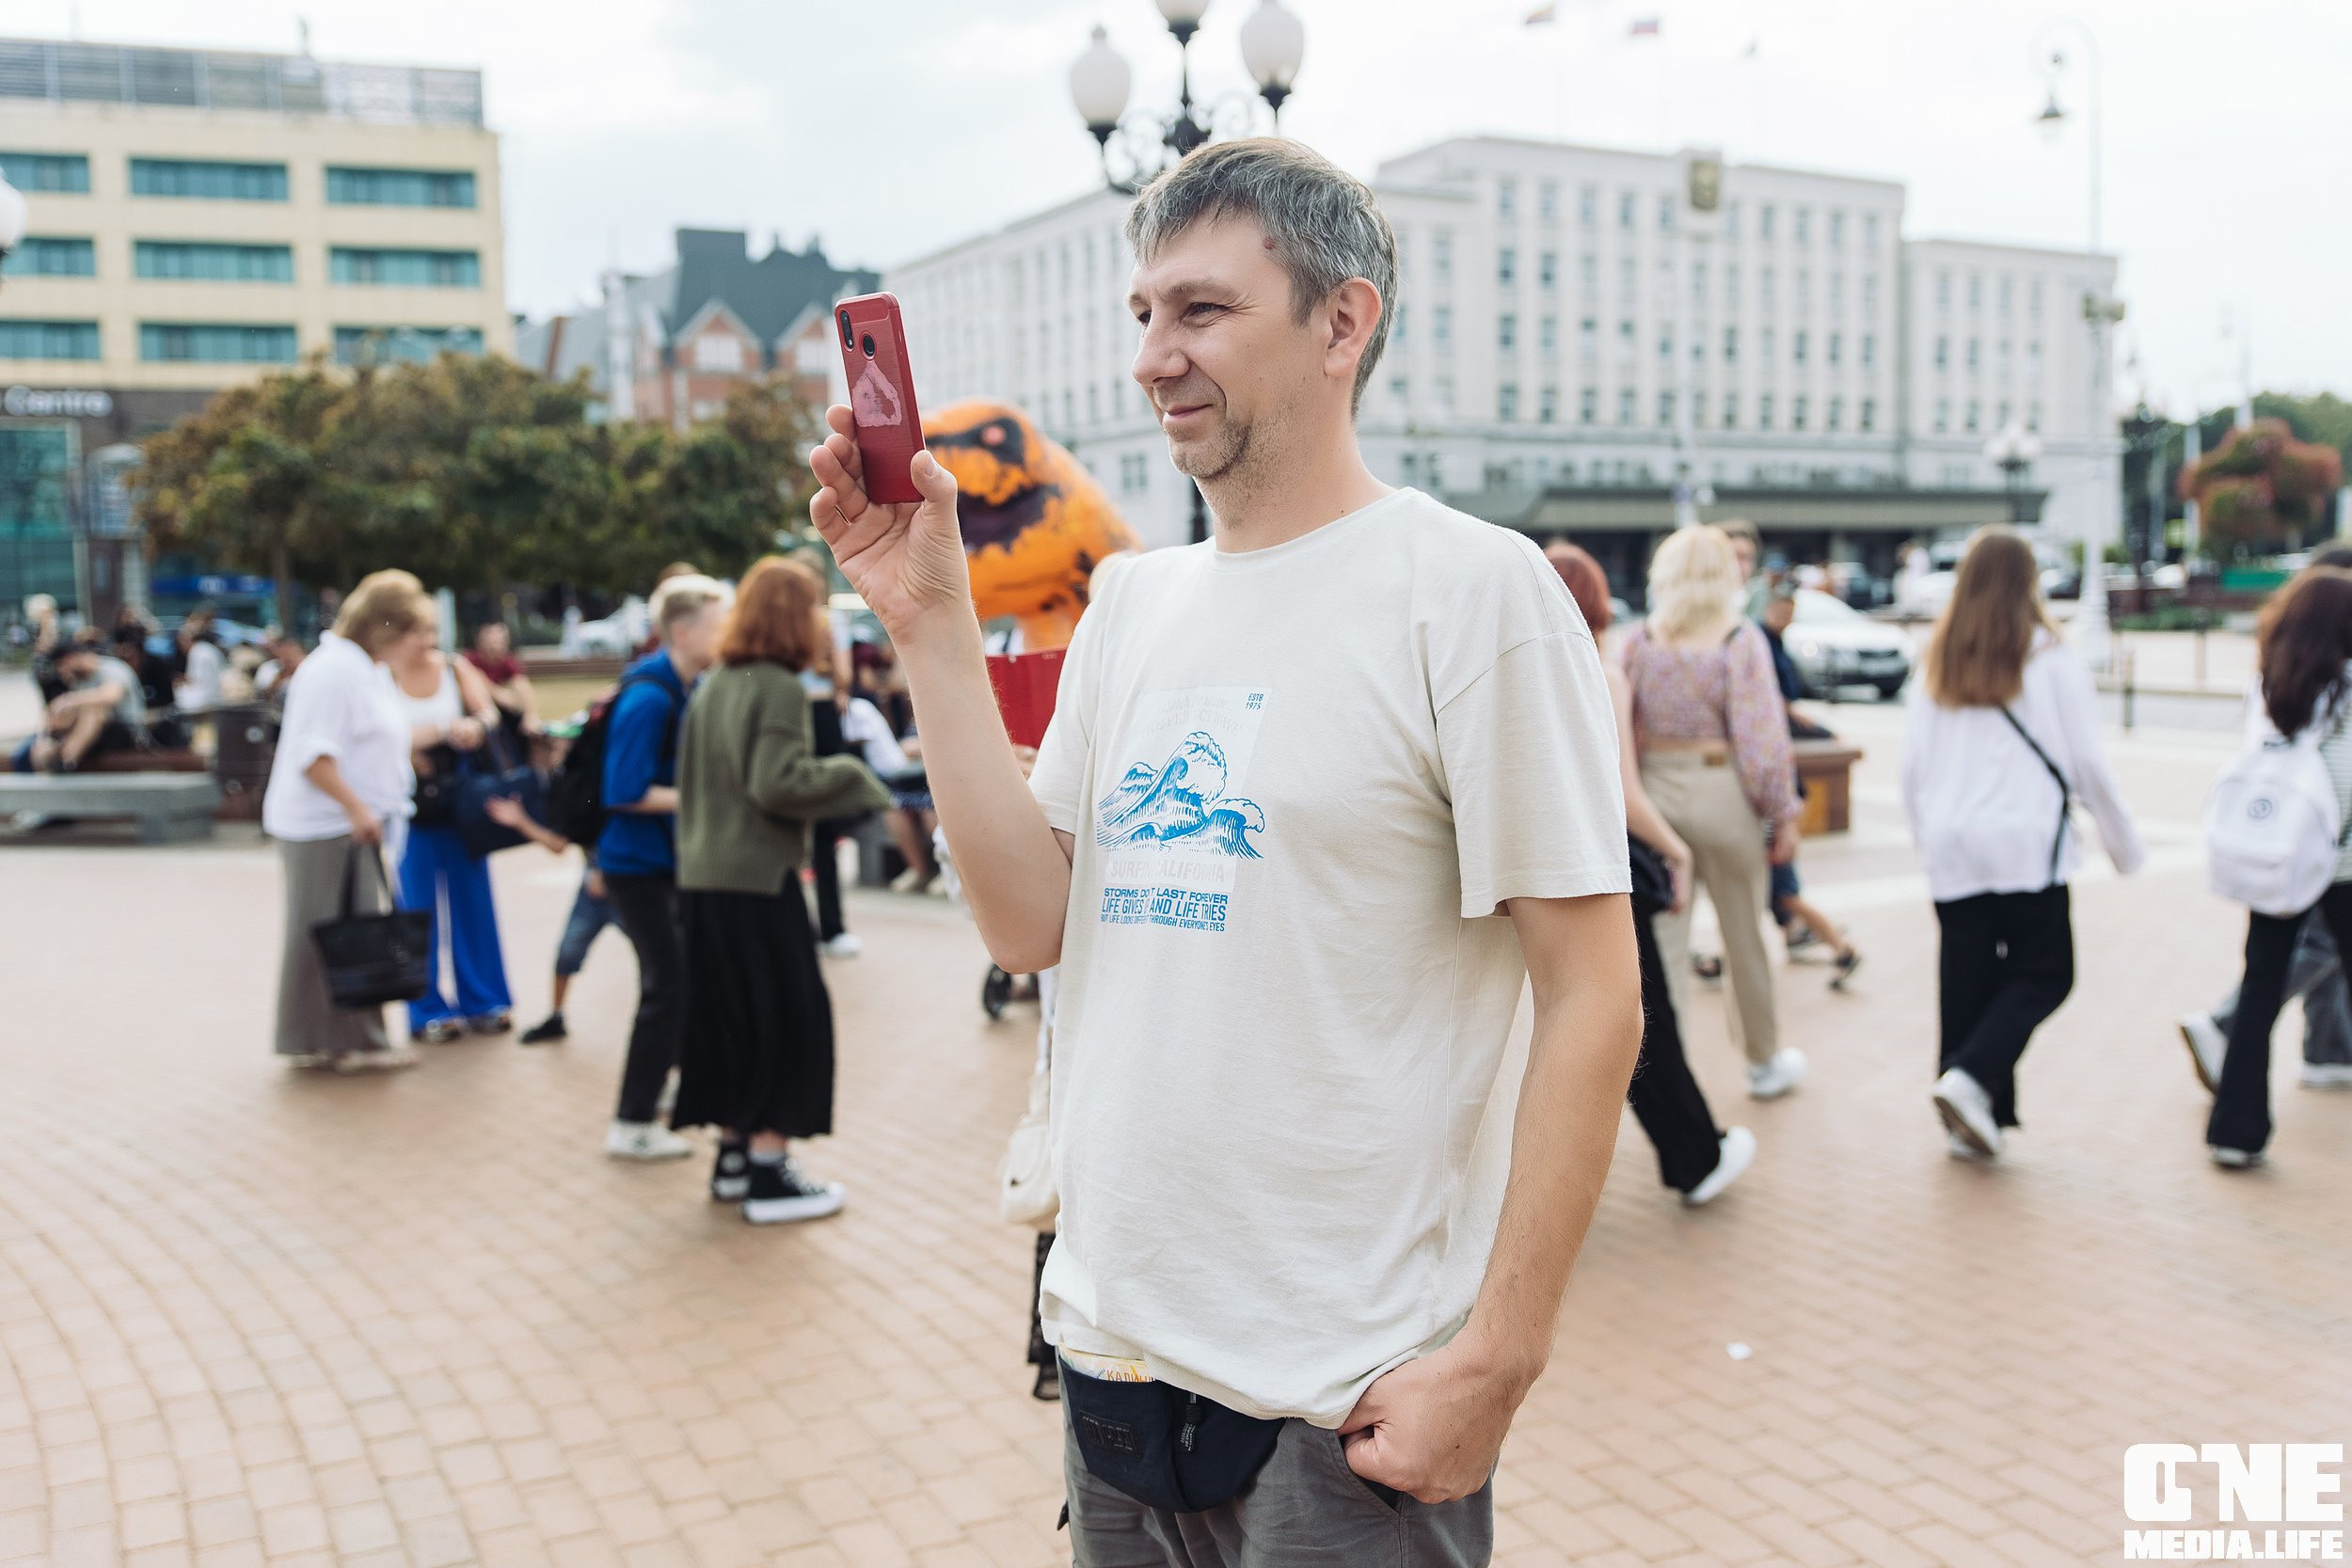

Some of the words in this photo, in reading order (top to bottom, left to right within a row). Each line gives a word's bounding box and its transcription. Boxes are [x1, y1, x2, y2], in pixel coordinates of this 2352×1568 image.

[1246, 702, 1262, 710] 1975
[1104, 887, 1139, 898] STORMS
[1156, 887, 1186, 900] LAST
[1188, 892, 1229, 905] FOREVER
[1102, 897, 1121, 913] LIFE
[1121, 898, 1144, 914] GIVES
[1149, 897, 1173, 915] AND
[1174, 900, 1200, 919] LIFE
[1200, 903, 1227, 922] TRIES
[1108, 914, 1120, 924] LIFE
[1150, 914, 1178, 927] THROUGH
[1209, 921, 1225, 932] EYES
